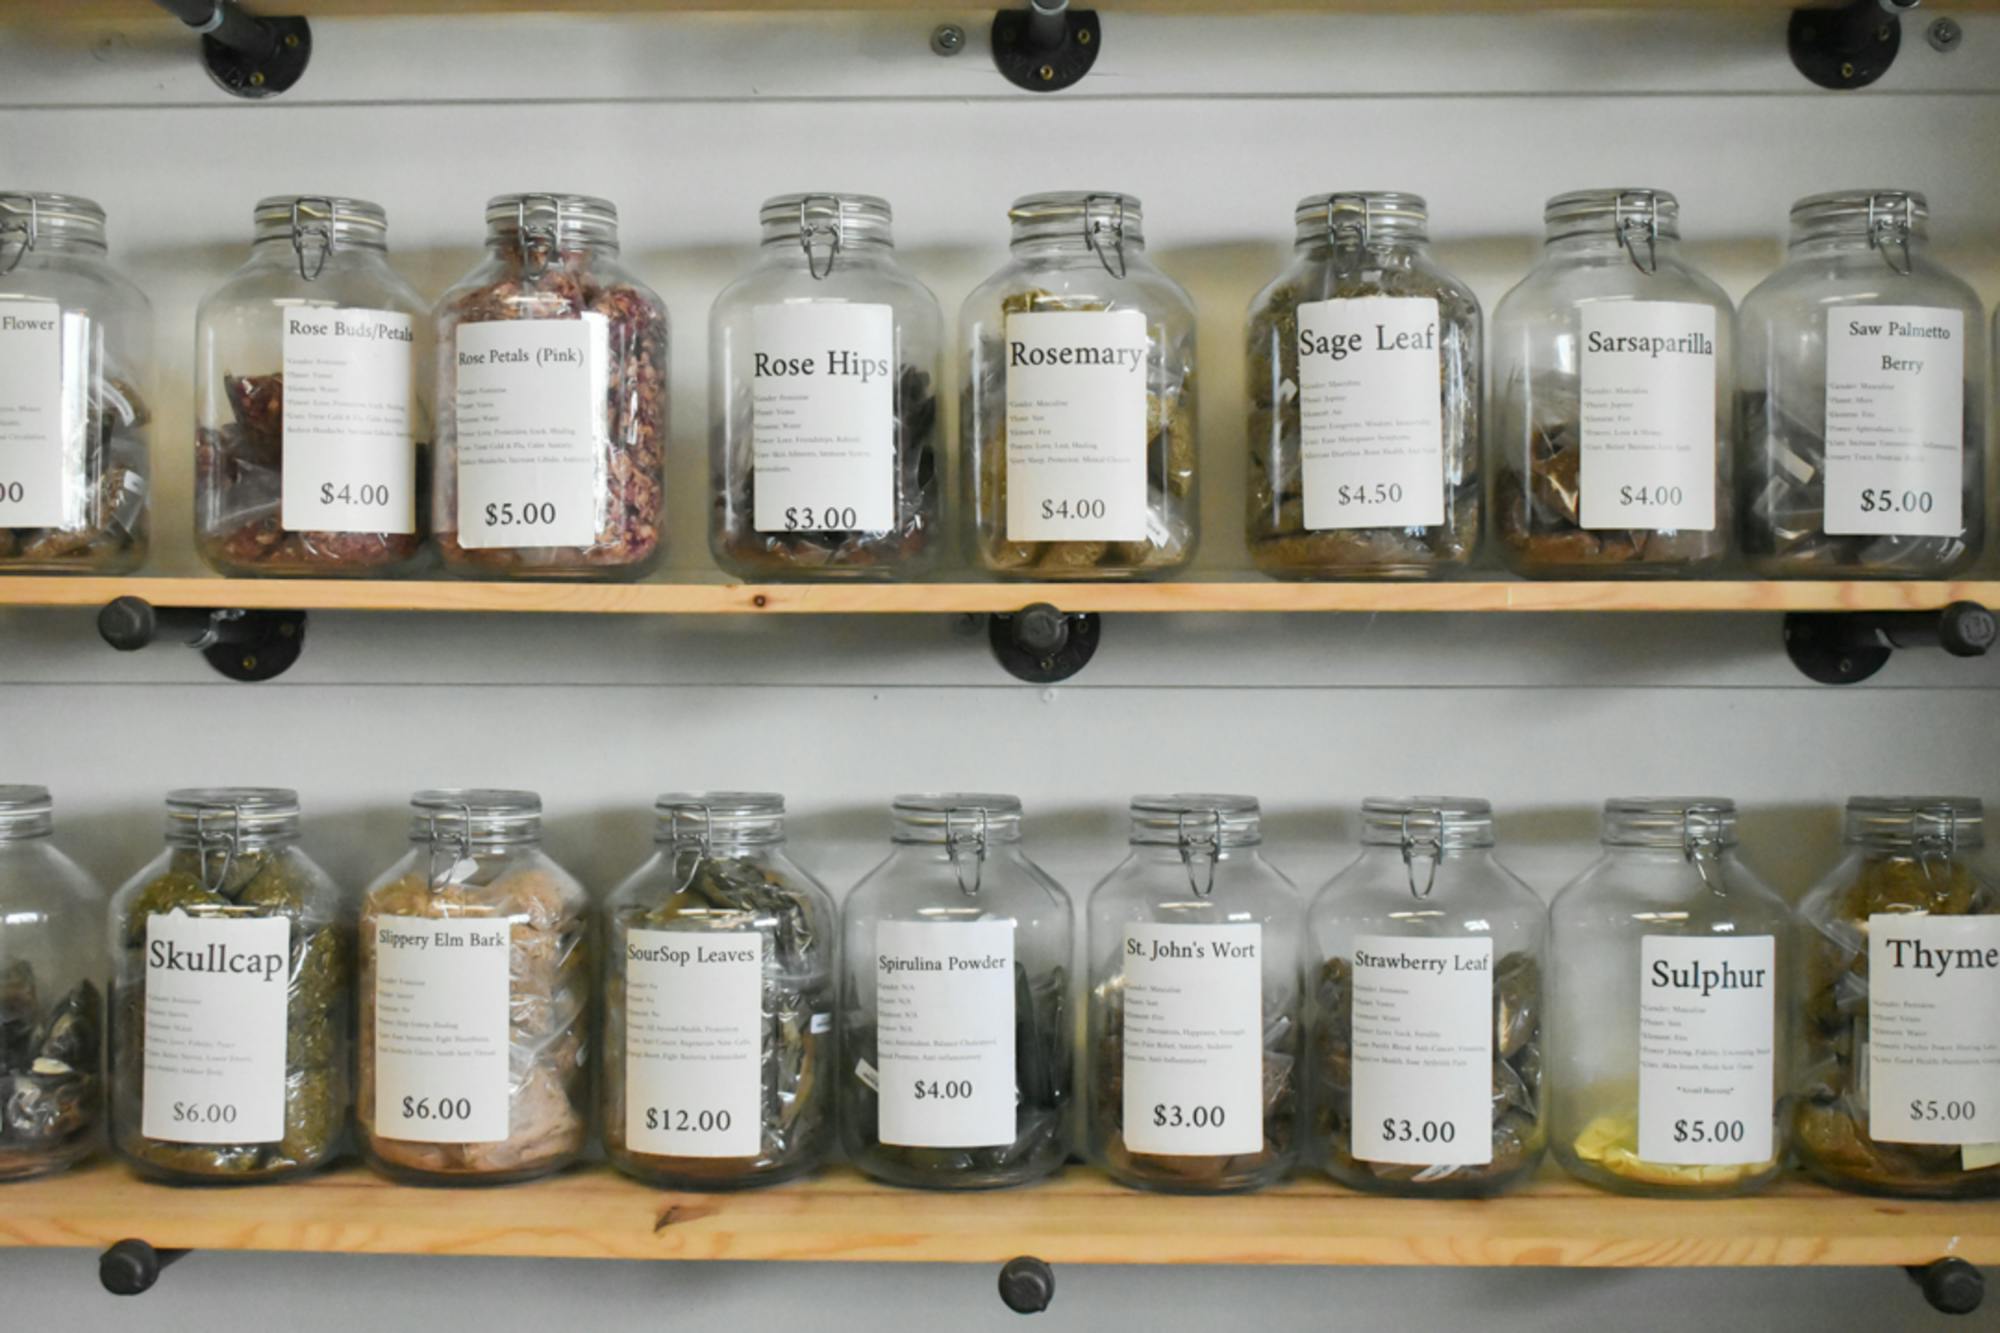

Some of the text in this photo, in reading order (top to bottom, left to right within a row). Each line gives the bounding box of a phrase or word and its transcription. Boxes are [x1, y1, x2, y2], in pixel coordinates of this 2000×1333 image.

[2, 315, 54, 331] Flower
[289, 320, 414, 342] Rose Buds/Petals
[1849, 321, 1951, 339] Saw Palmetto
[1300, 324, 1434, 359] Sage Leaf
[1588, 331, 1712, 358] Sarsaparilla
[458, 348, 584, 367] Rose Petals (Pink)
[754, 351, 888, 382] Rose Hips
[1010, 342, 1142, 372] Rosemary
[1881, 356, 1923, 374] Berry
[320, 482, 389, 506] $4.00
[1338, 483, 1402, 505] $4.50
[1619, 485, 1682, 506] $4.00
[1860, 489, 1933, 513] $5.00
[485, 502, 556, 526] $5.00
[785, 507, 857, 531] $3.00
[1041, 499, 1105, 520] $4.00
[379, 929, 504, 949] Slippery Elm Bark
[1127, 938, 1255, 960] St. John's Wort
[150, 940, 282, 981] Skullcap
[628, 944, 754, 966] SourSop Leaves
[879, 955, 1006, 973] Spirulina Powder
[1355, 950, 1489, 974] Strawberry Leaf
[1886, 940, 2000, 977] Thyme
[1651, 960, 1765, 996] Sulphur
[914, 1080, 972, 1099] $4.00
[173, 1102, 237, 1123] $6.00
[402, 1096, 471, 1120] $6.00
[646, 1107, 731, 1132] $12.00
[1153, 1104, 1225, 1127] $3.00
[1910, 1100, 1976, 1120] $5.00
[1382, 1118, 1455, 1143] $3.00
[1673, 1119, 1744, 1142] $5.00
